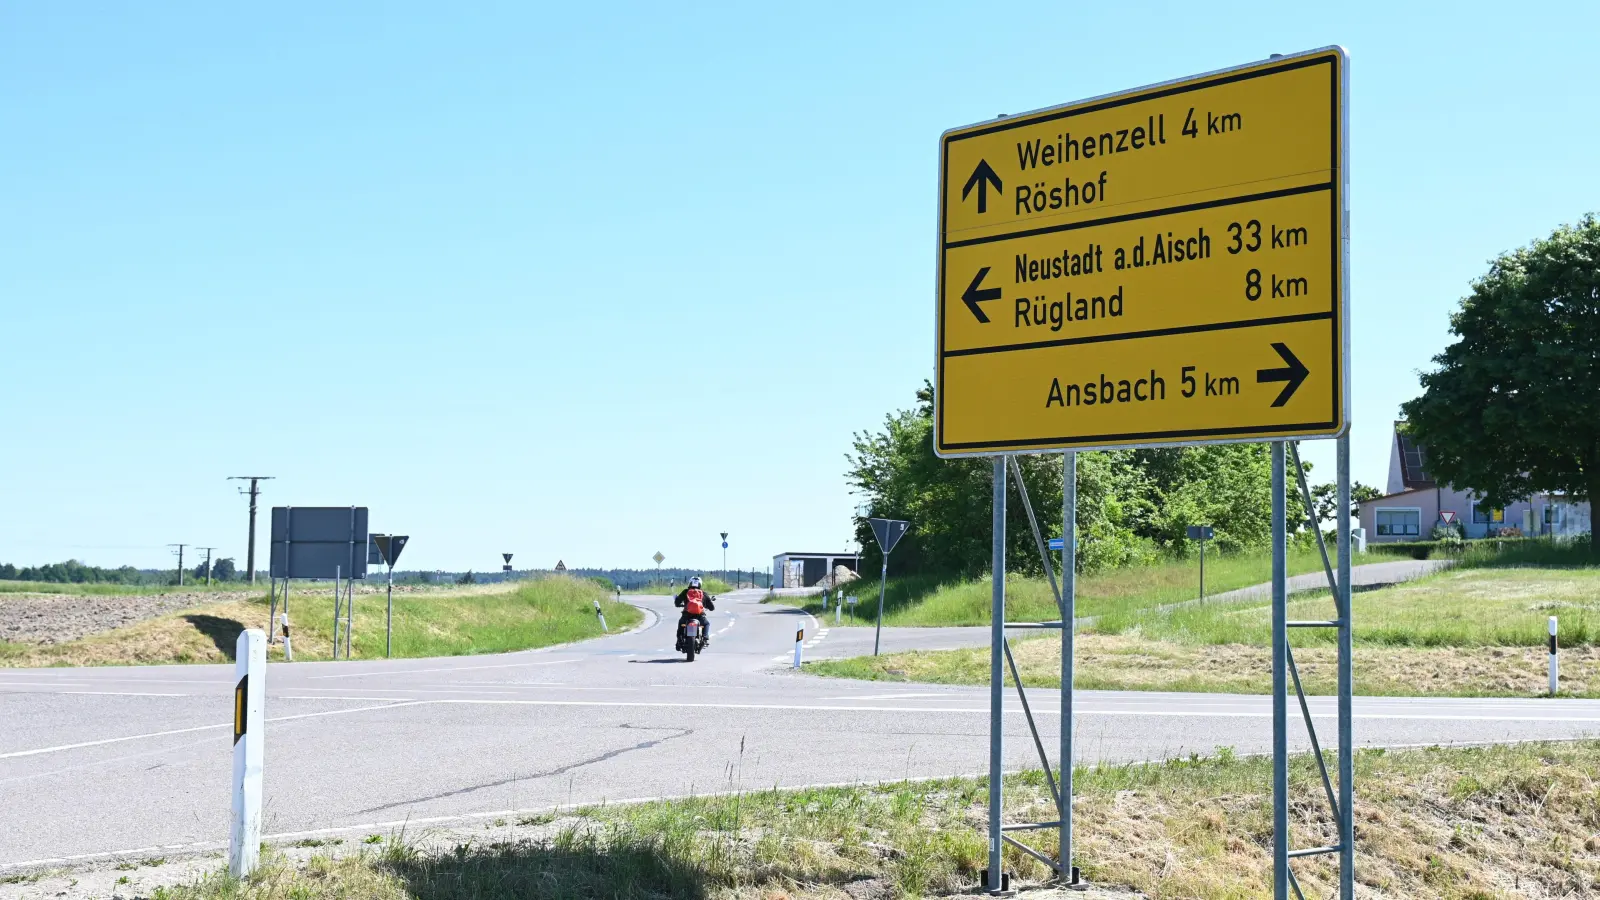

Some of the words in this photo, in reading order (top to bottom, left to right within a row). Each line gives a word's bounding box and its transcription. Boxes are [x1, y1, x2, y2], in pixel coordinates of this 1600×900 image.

[1016, 113, 1166, 171] Weihenzell
[1181, 107, 1199, 139] 4
[1207, 111, 1242, 136] km
[1015, 170, 1107, 216] Röshof
[1015, 243, 1103, 284] Neustadt
[1114, 227, 1211, 271] a.d.Aisch
[1226, 219, 1262, 255] 33
[1271, 224, 1308, 250] km
[1014, 285, 1123, 332] Rügland
[1245, 268, 1262, 302] 8
[1271, 273, 1308, 299] km
[1045, 369, 1166, 409] Ansbach
[1180, 365, 1196, 399] 5
[1205, 372, 1240, 397] km
